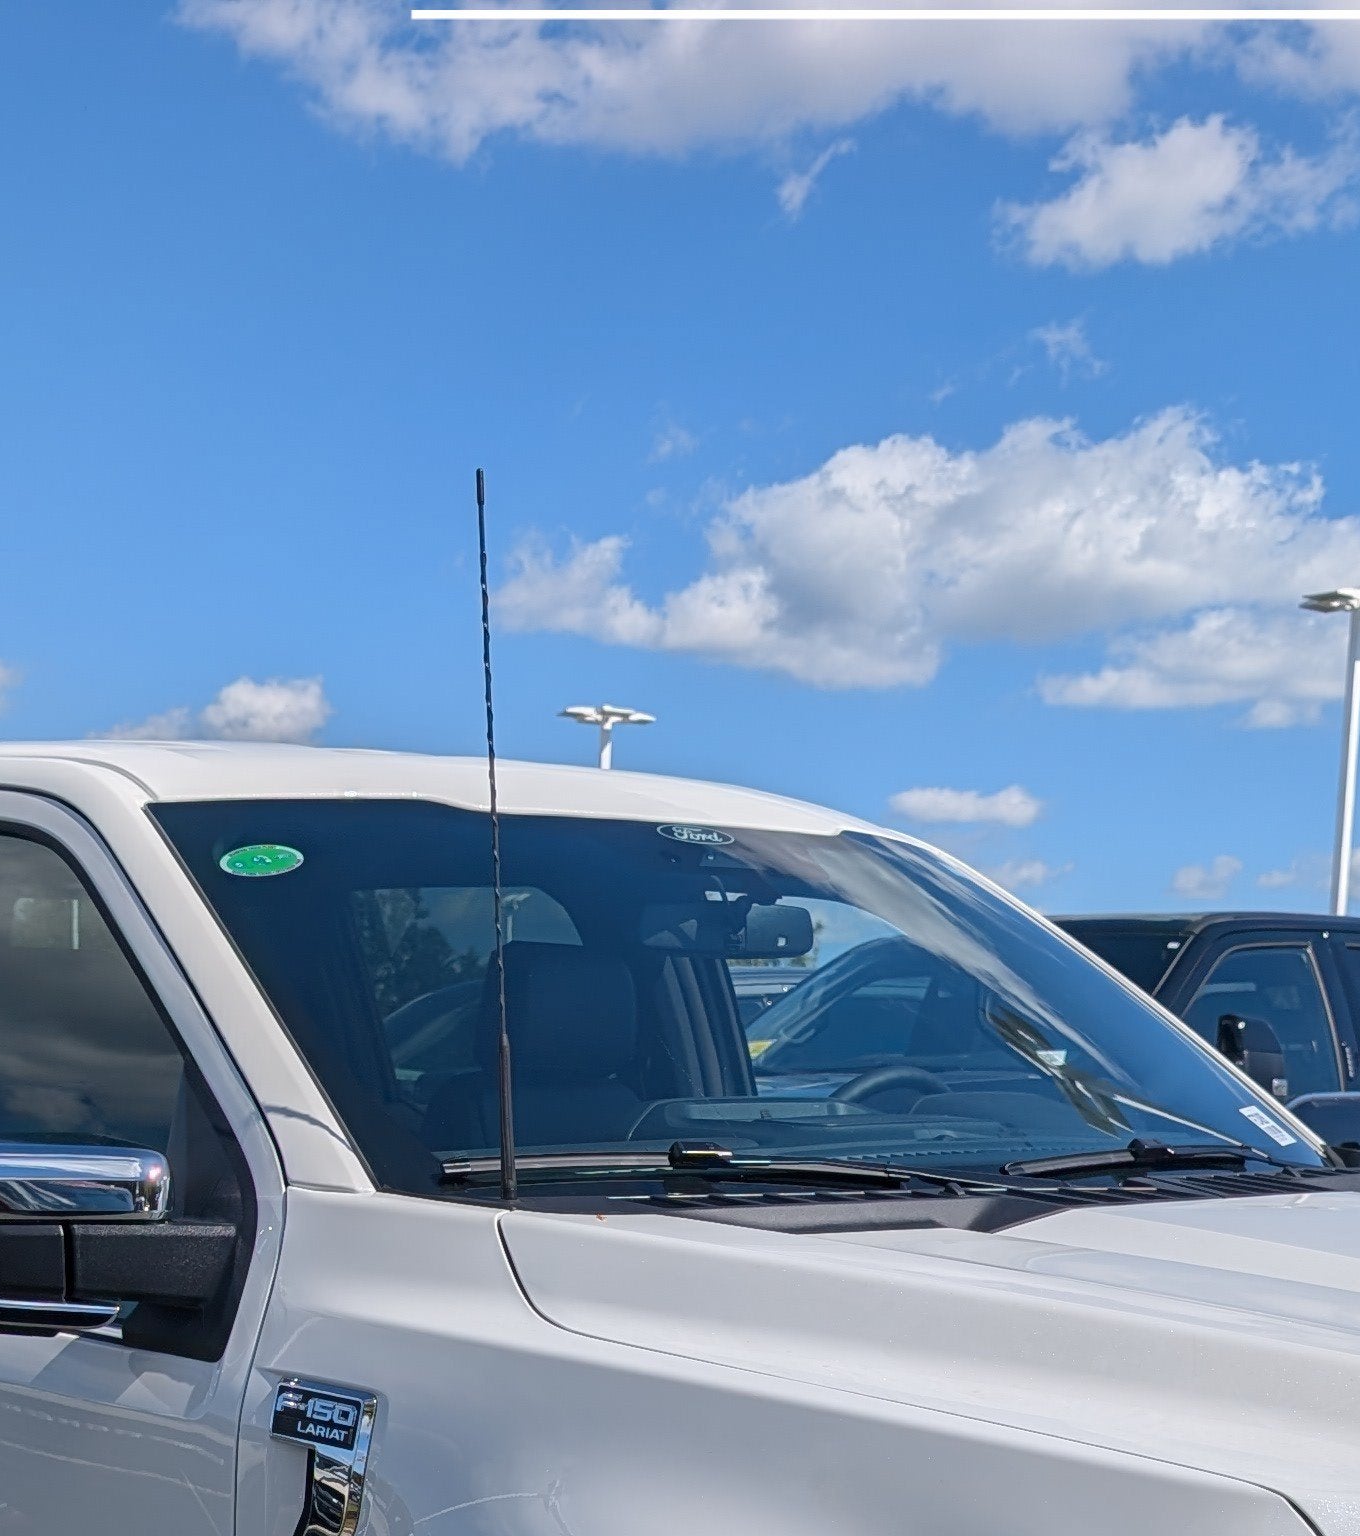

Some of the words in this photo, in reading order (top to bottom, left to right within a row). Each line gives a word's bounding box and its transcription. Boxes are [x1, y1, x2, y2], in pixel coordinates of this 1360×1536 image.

[672, 826, 723, 842] Ford
[275, 1392, 358, 1427] F-150
[297, 1420, 349, 1442] LARIAT
